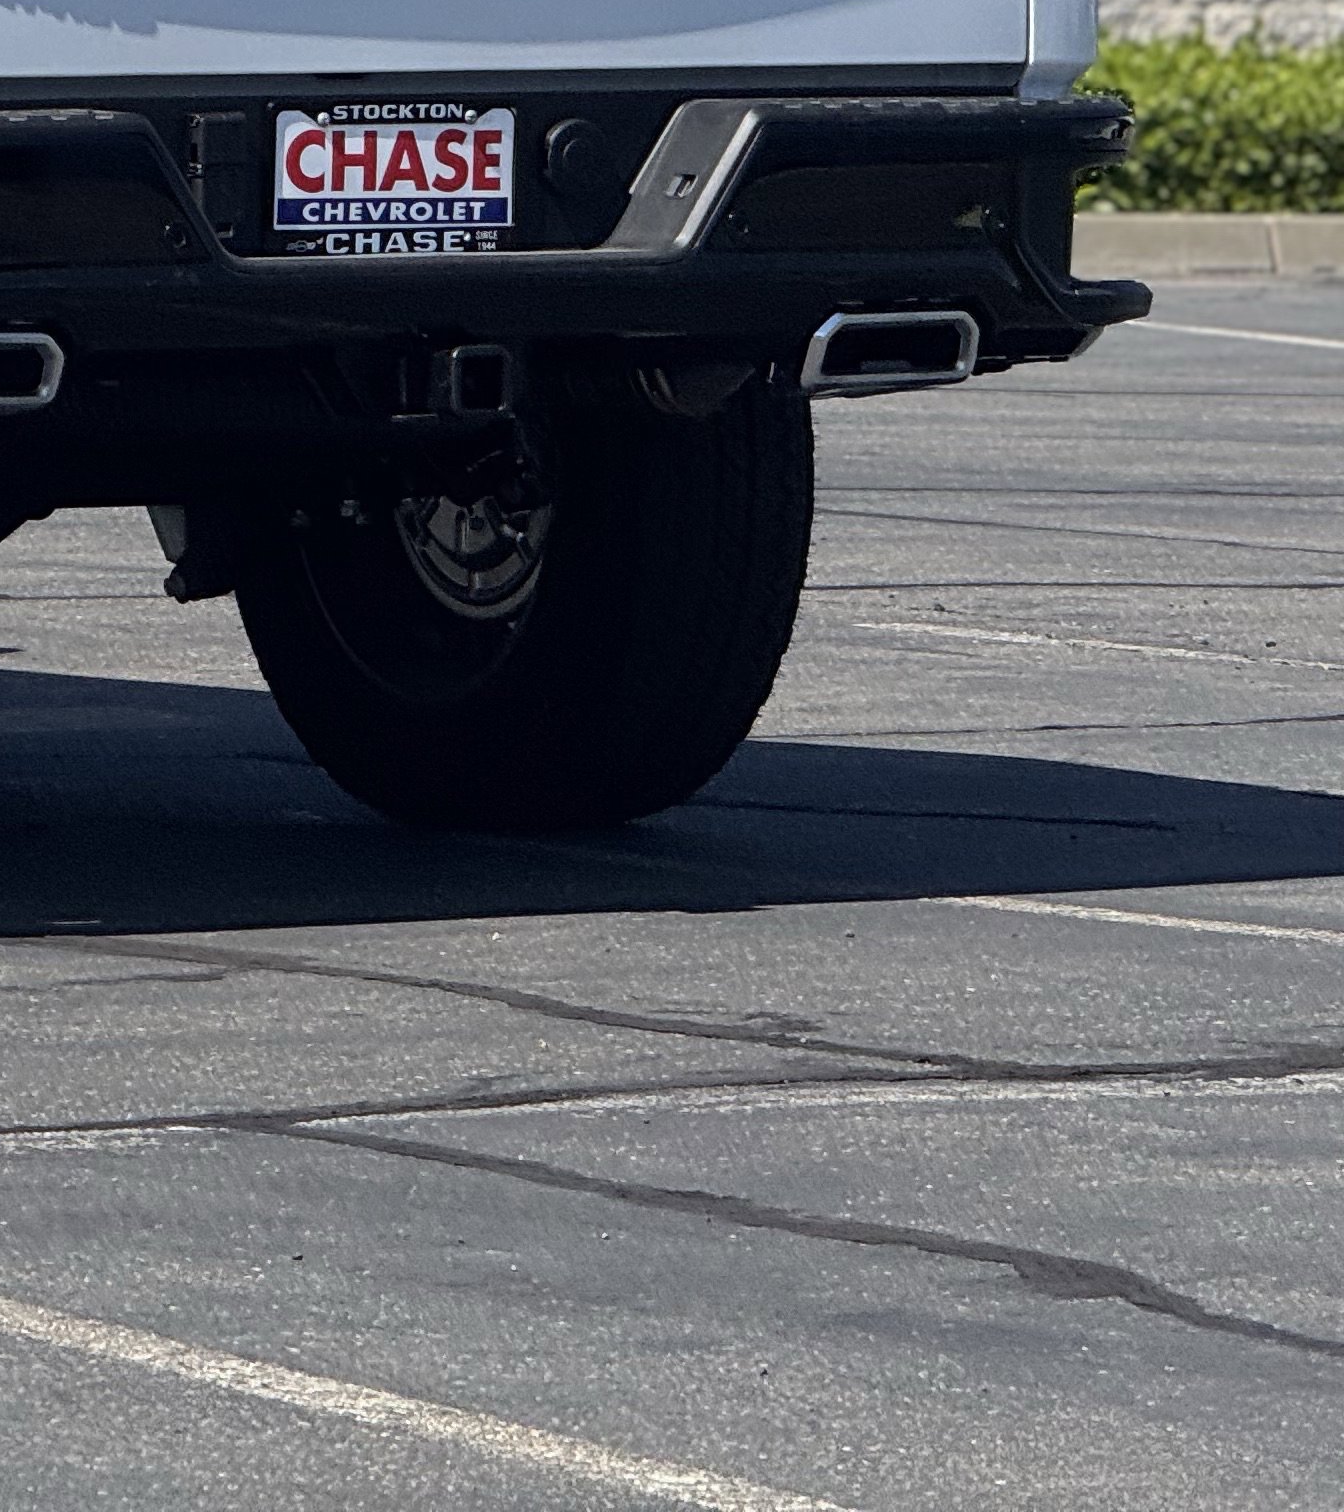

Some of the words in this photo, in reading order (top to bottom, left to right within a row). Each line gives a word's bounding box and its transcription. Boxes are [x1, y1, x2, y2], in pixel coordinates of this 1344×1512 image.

[331, 103, 464, 120] STOCKTON
[285, 128, 503, 193] CHASE
[301, 201, 486, 222] CHEVROLET
[325, 231, 465, 254] CHASE
